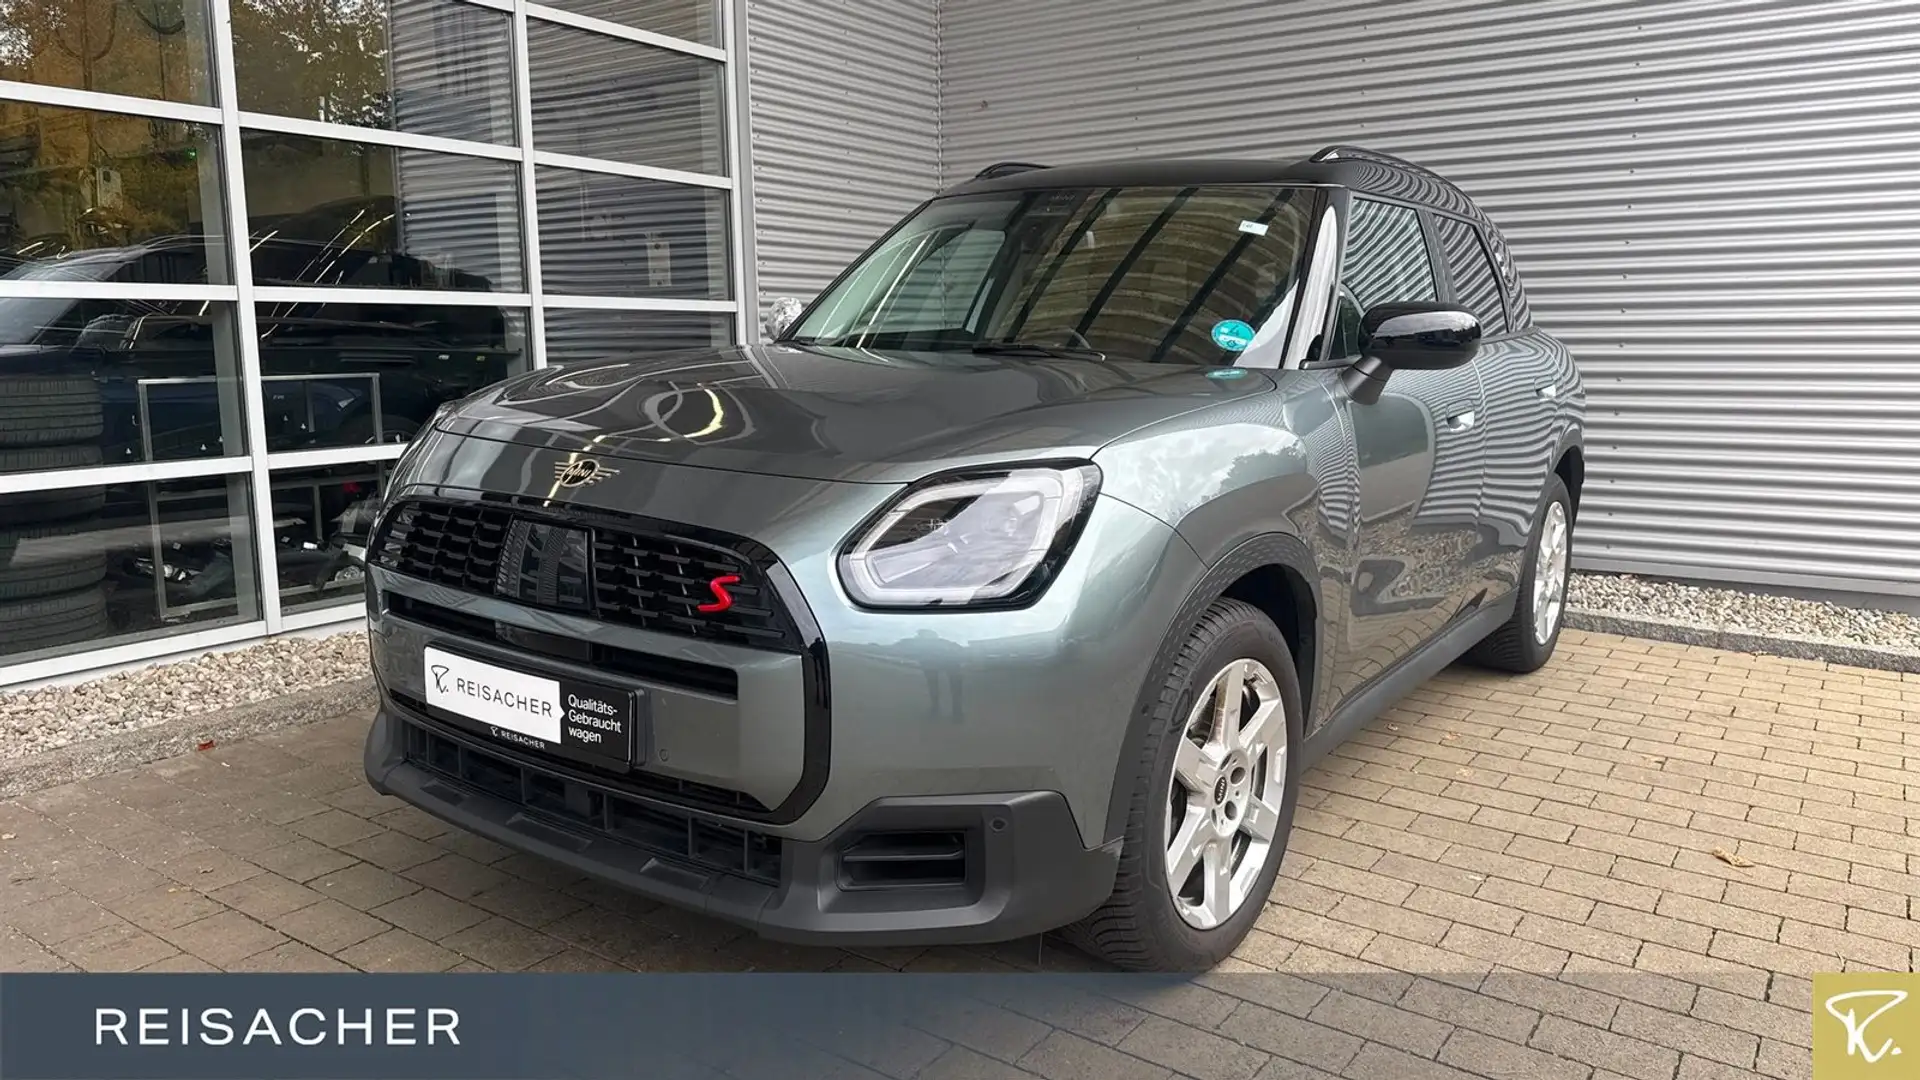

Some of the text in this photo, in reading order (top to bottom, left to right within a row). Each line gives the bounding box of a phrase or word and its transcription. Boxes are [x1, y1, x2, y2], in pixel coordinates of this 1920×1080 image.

[696, 575, 741, 612] S
[456, 677, 553, 718] REISACHER
[567, 693, 619, 716] Qualitäts-
[567, 709, 622, 734] Gebraucht
[500, 730, 546, 750] REISACHER
[567, 726, 602, 744] wagen
